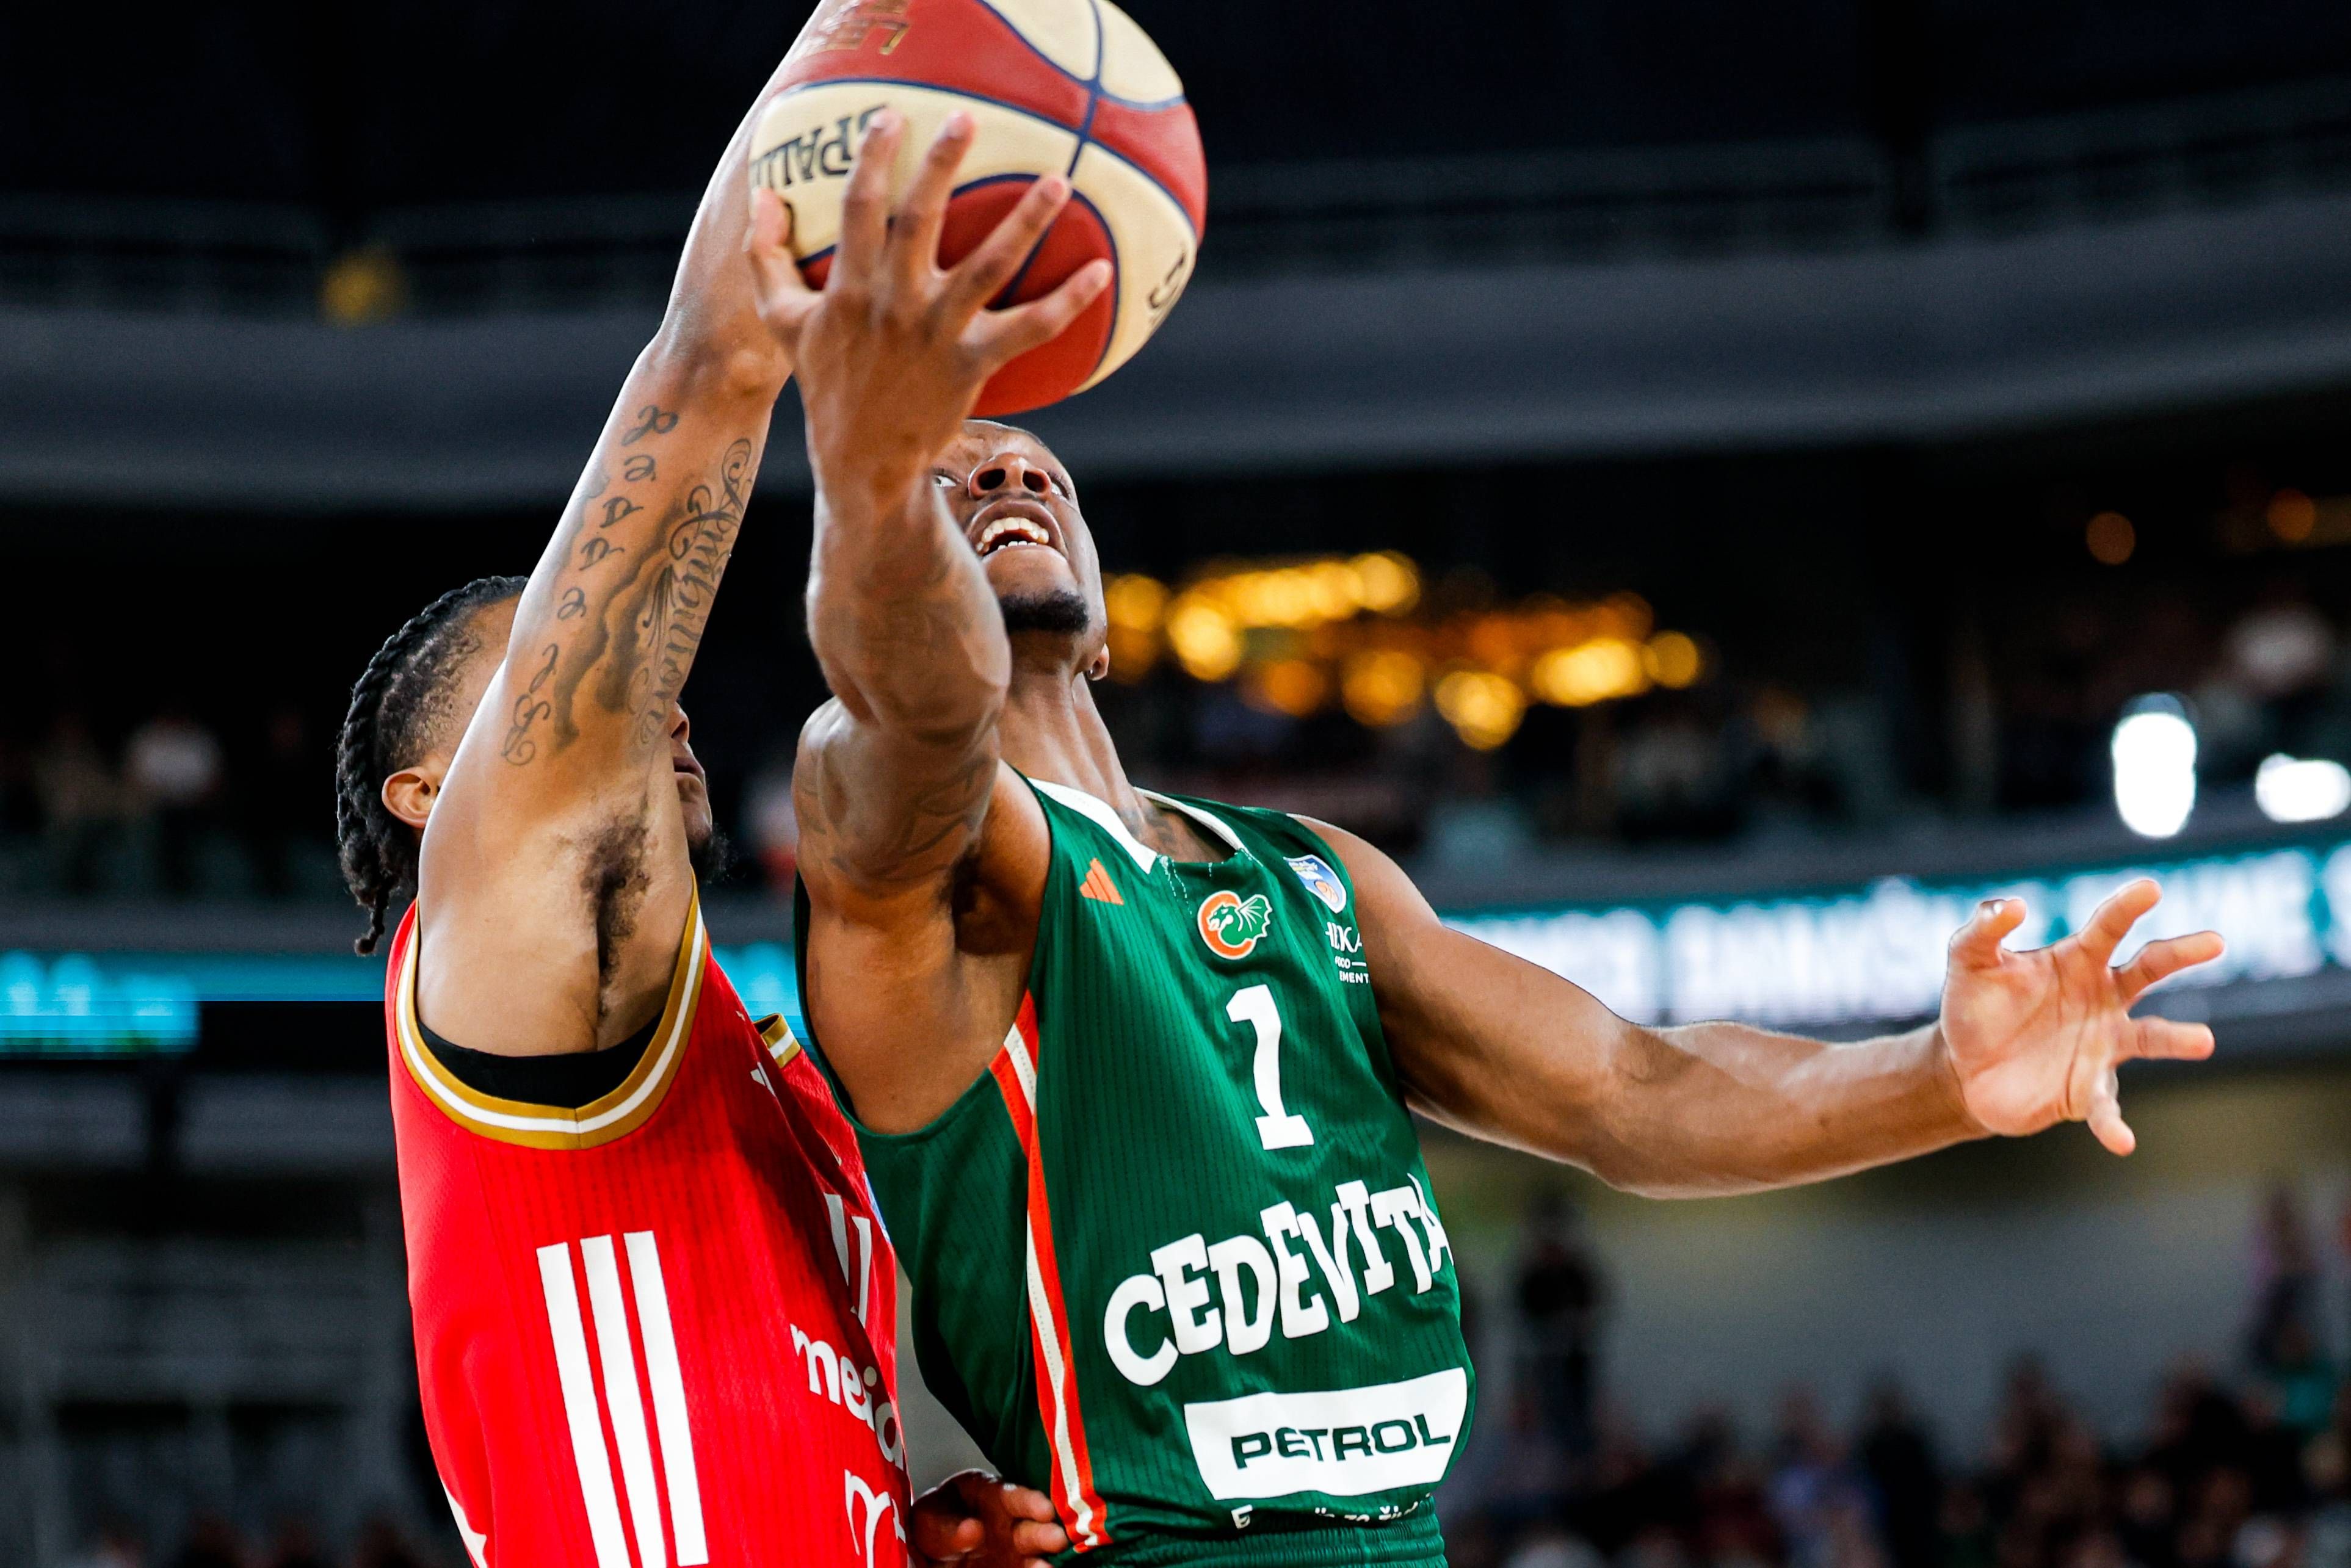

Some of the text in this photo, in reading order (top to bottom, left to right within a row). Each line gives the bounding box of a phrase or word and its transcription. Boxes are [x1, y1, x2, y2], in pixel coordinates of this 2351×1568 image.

[1226, 984, 1314, 1151] 1
[1104, 1172, 1454, 1386] CEDEVITA
[1231, 1413, 1451, 1470] PETROL
